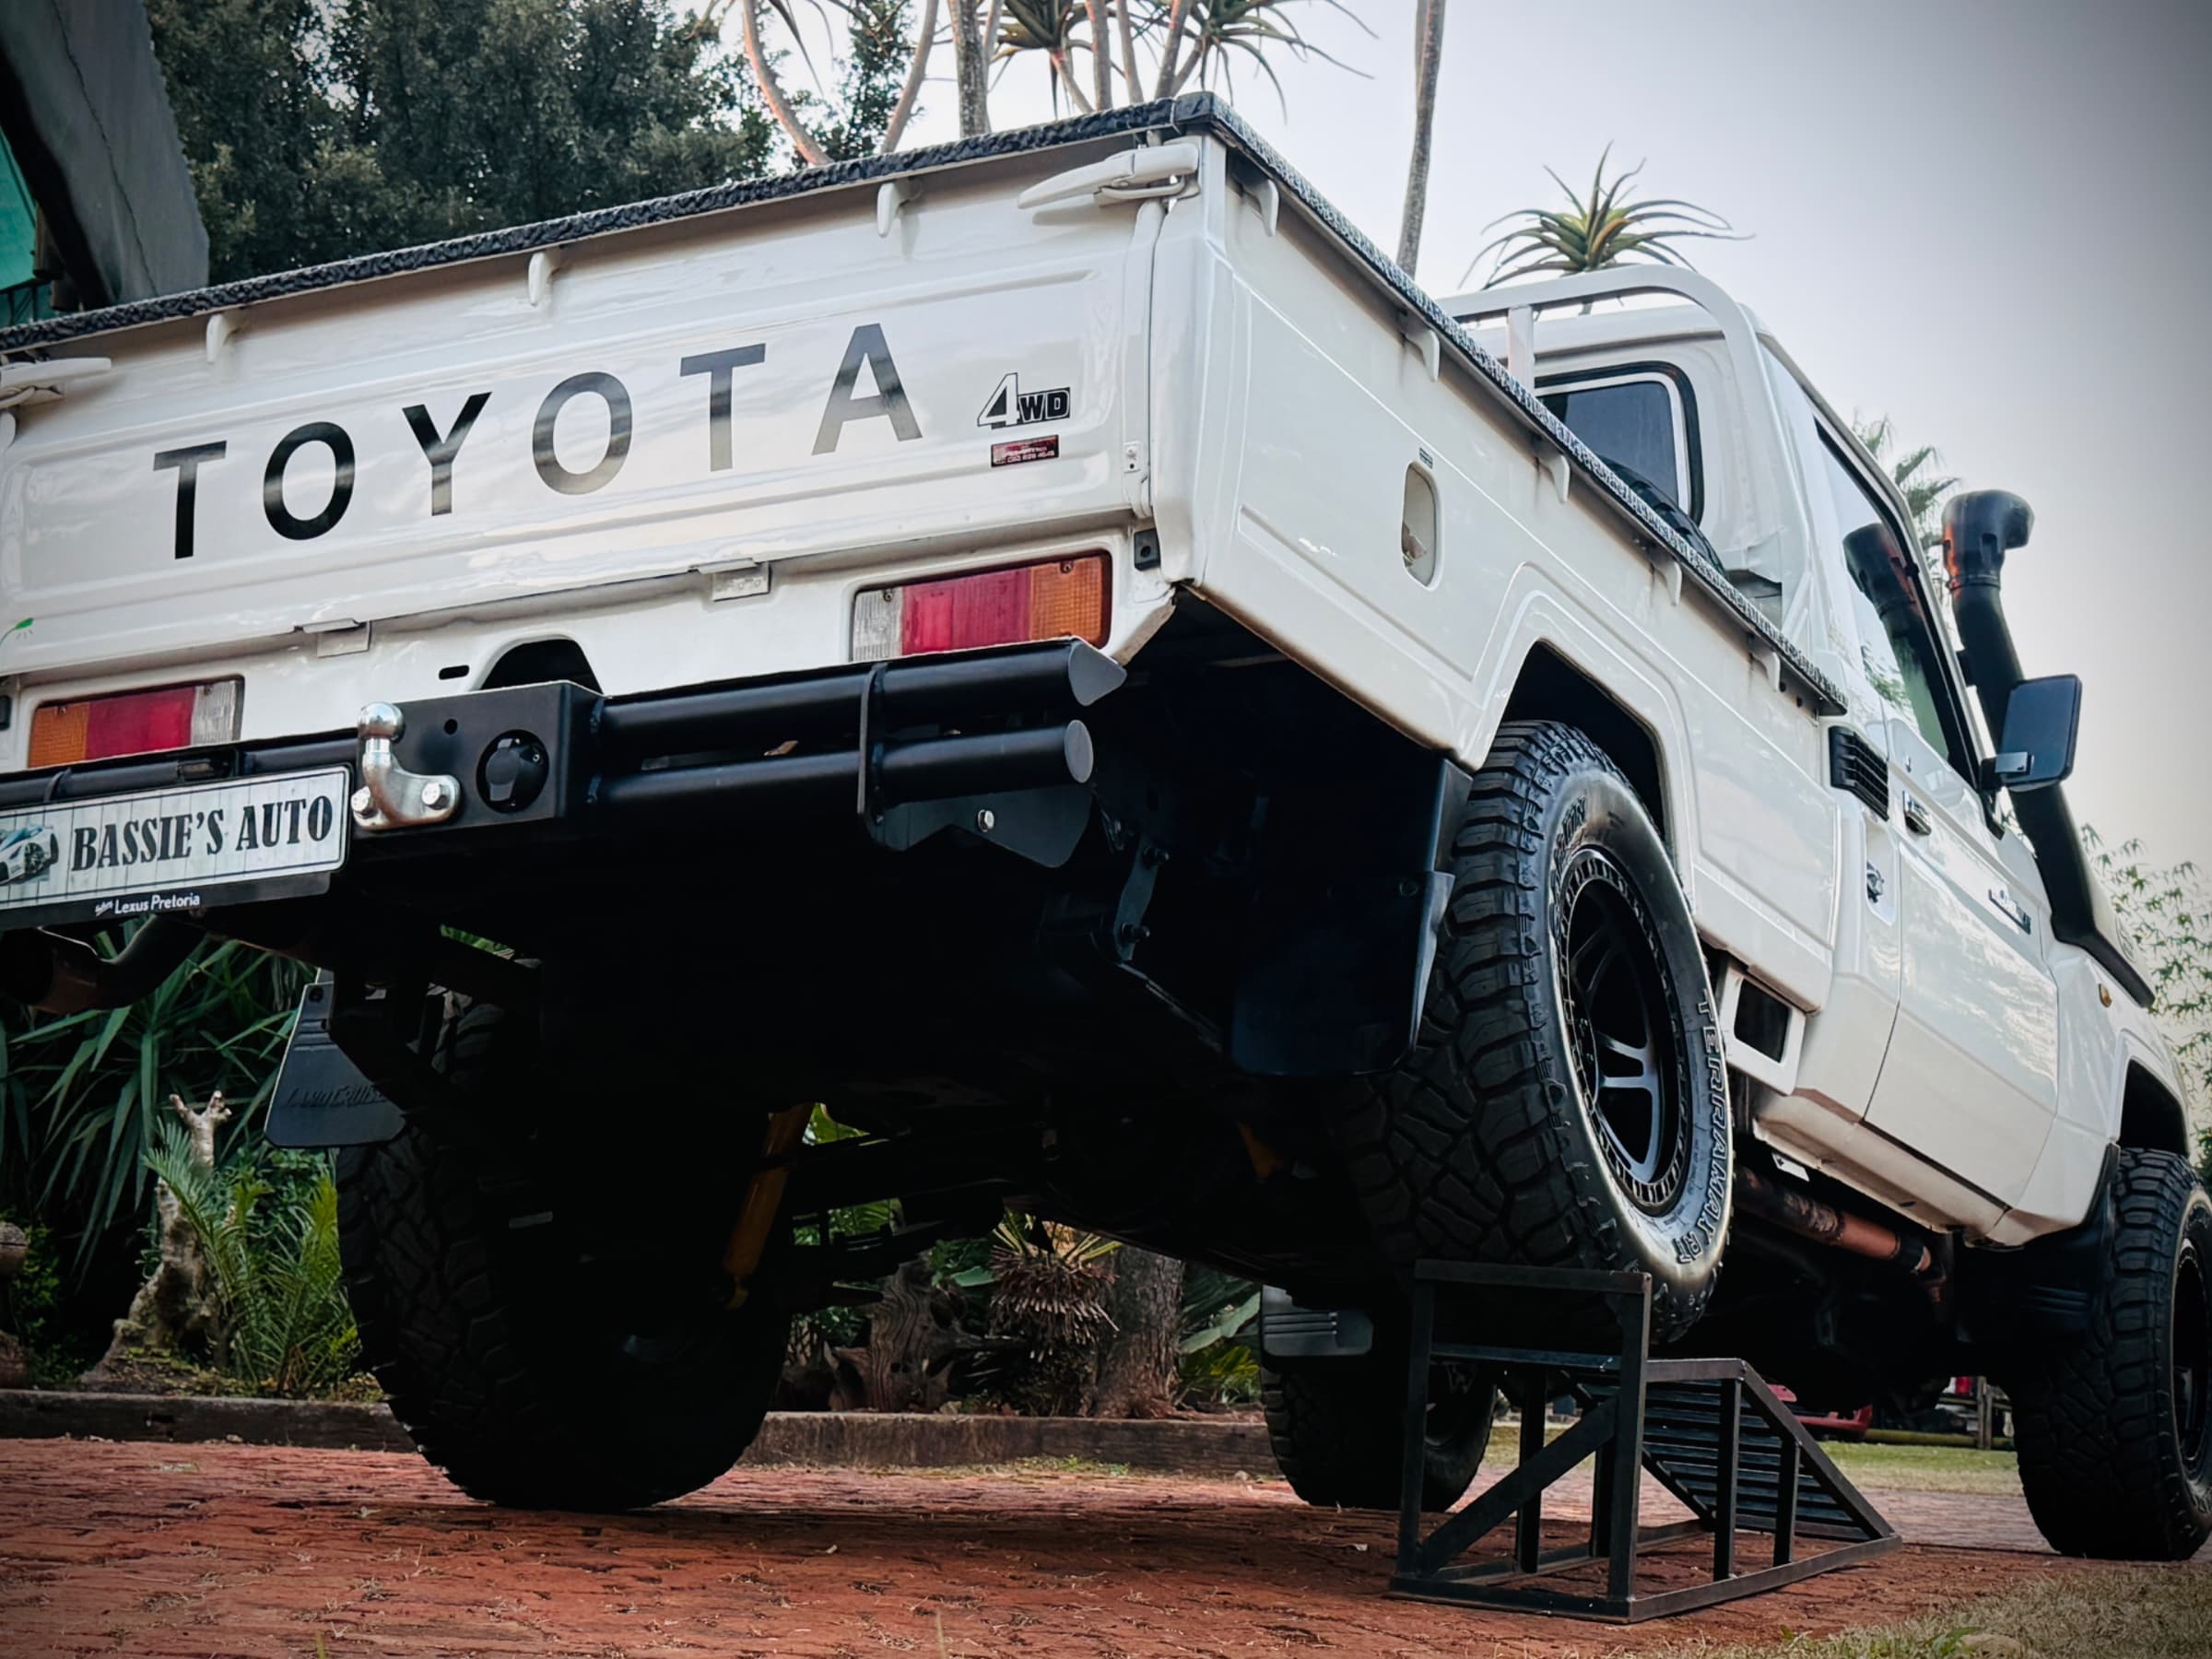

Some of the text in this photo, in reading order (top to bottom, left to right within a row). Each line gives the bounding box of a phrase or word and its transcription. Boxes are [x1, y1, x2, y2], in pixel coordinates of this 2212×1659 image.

[977, 371, 1070, 429] 4WD
[153, 323, 924, 560] TOYOTA
[71, 795, 333, 872] BASSIE'S AUTO
[114, 899, 149, 914] Lexus
[150, 892, 200, 911] Pretoria
